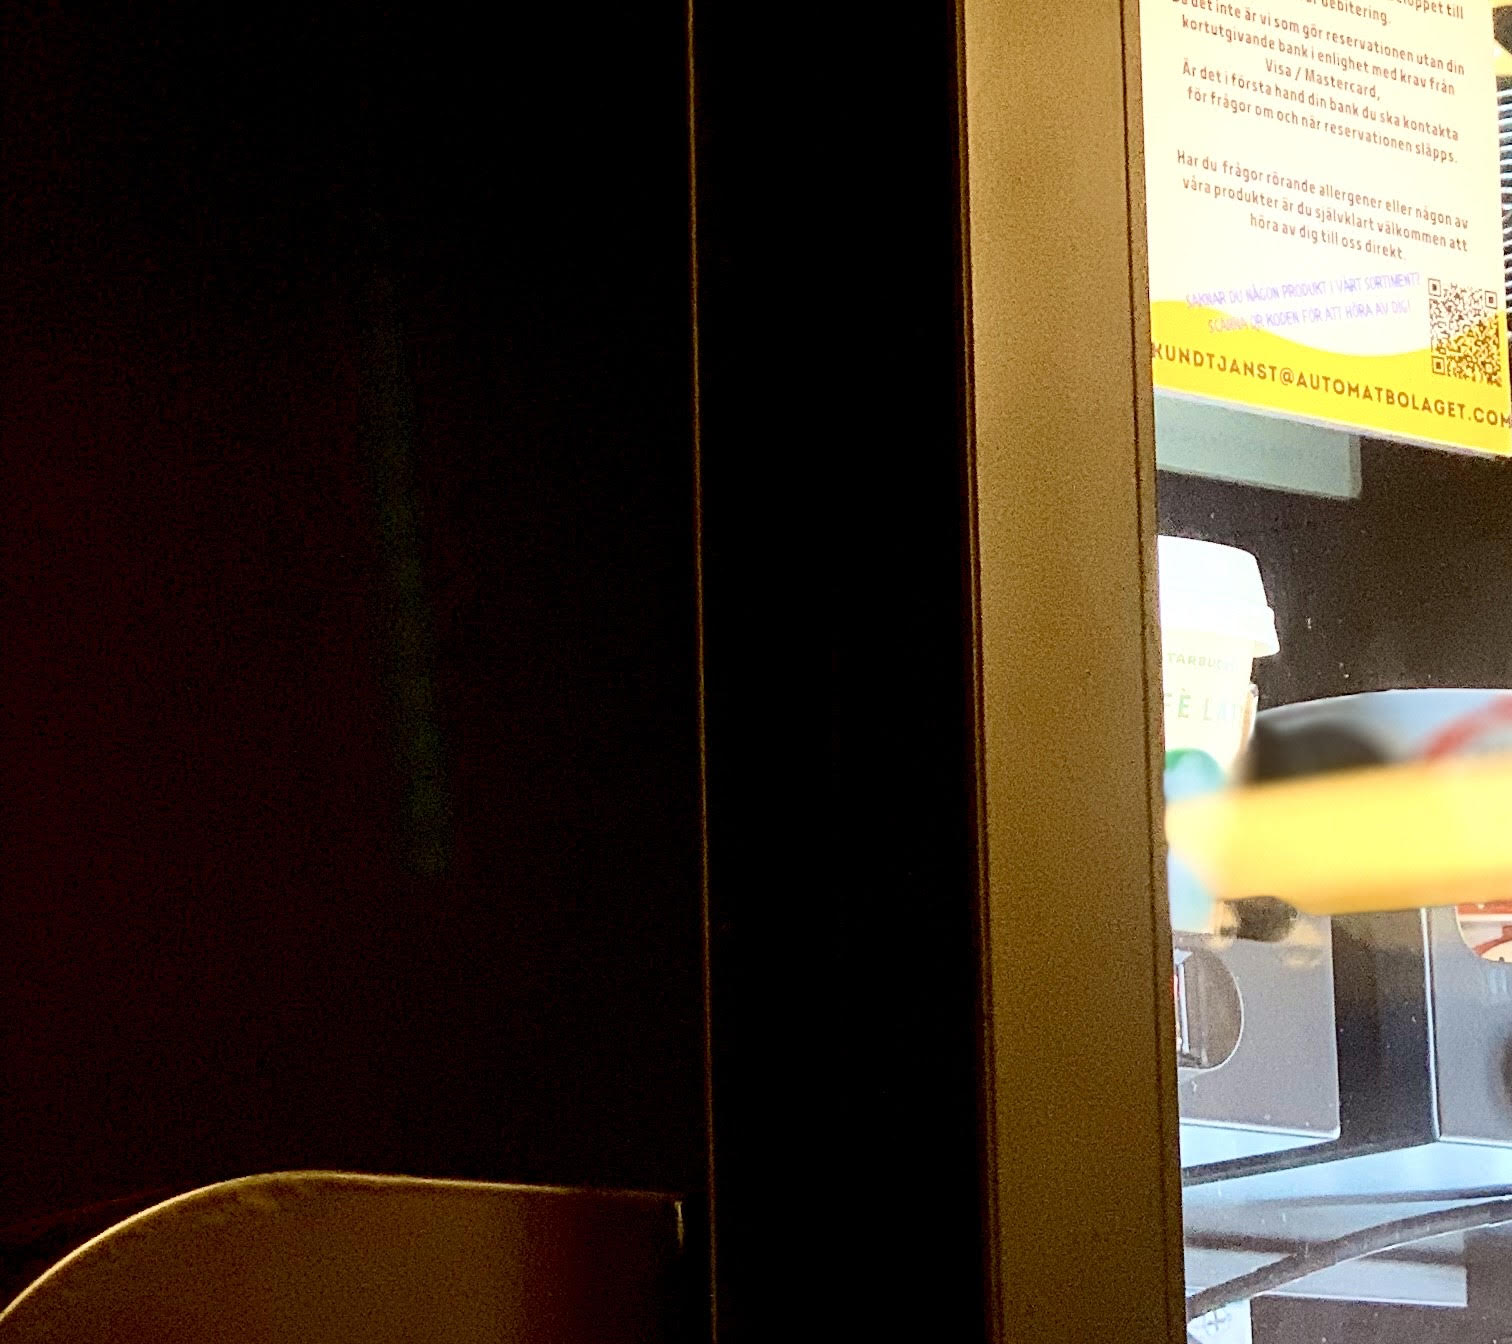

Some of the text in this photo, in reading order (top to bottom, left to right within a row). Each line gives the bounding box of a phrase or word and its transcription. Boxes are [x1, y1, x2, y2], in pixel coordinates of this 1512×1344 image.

[1446, 3, 1464, 20] till
[1177, 149, 1469, 230] Har du frågor rörande allergener eller någon av
[1182, 175, 1468, 252] våra produkter är du självklart välkommen att
[1249, 212, 1279, 233] höra
[1282, 223, 1296, 237] av
[1299, 224, 1319, 245] dig
[1321, 229, 1339, 245] till
[1341, 236, 1362, 251] oss
